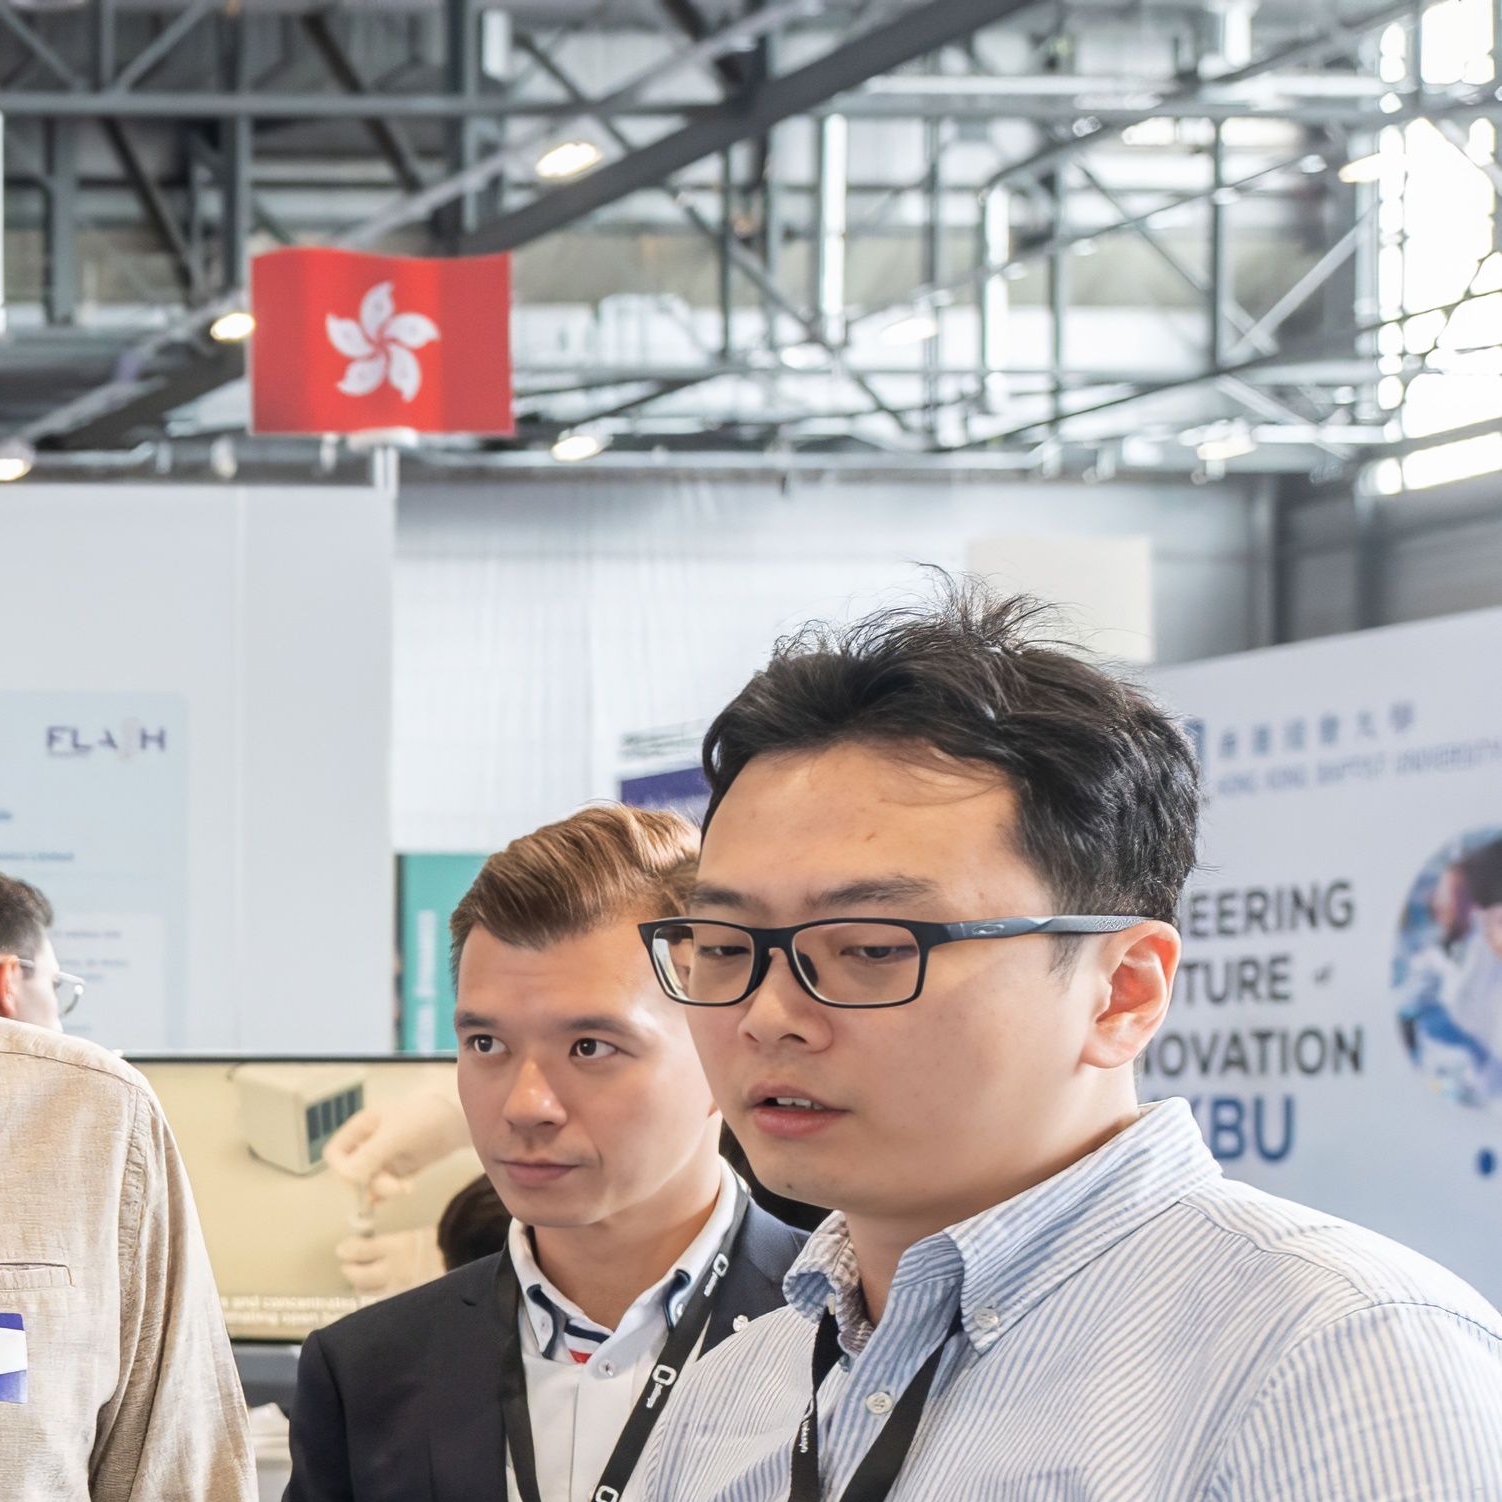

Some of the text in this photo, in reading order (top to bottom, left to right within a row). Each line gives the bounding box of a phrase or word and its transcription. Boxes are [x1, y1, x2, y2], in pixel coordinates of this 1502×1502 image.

[1187, 880, 1354, 937] EERING
[1177, 954, 1291, 1005] TURE
[1147, 1025, 1364, 1078] OVATION
[1202, 1095, 1296, 1162] BU
